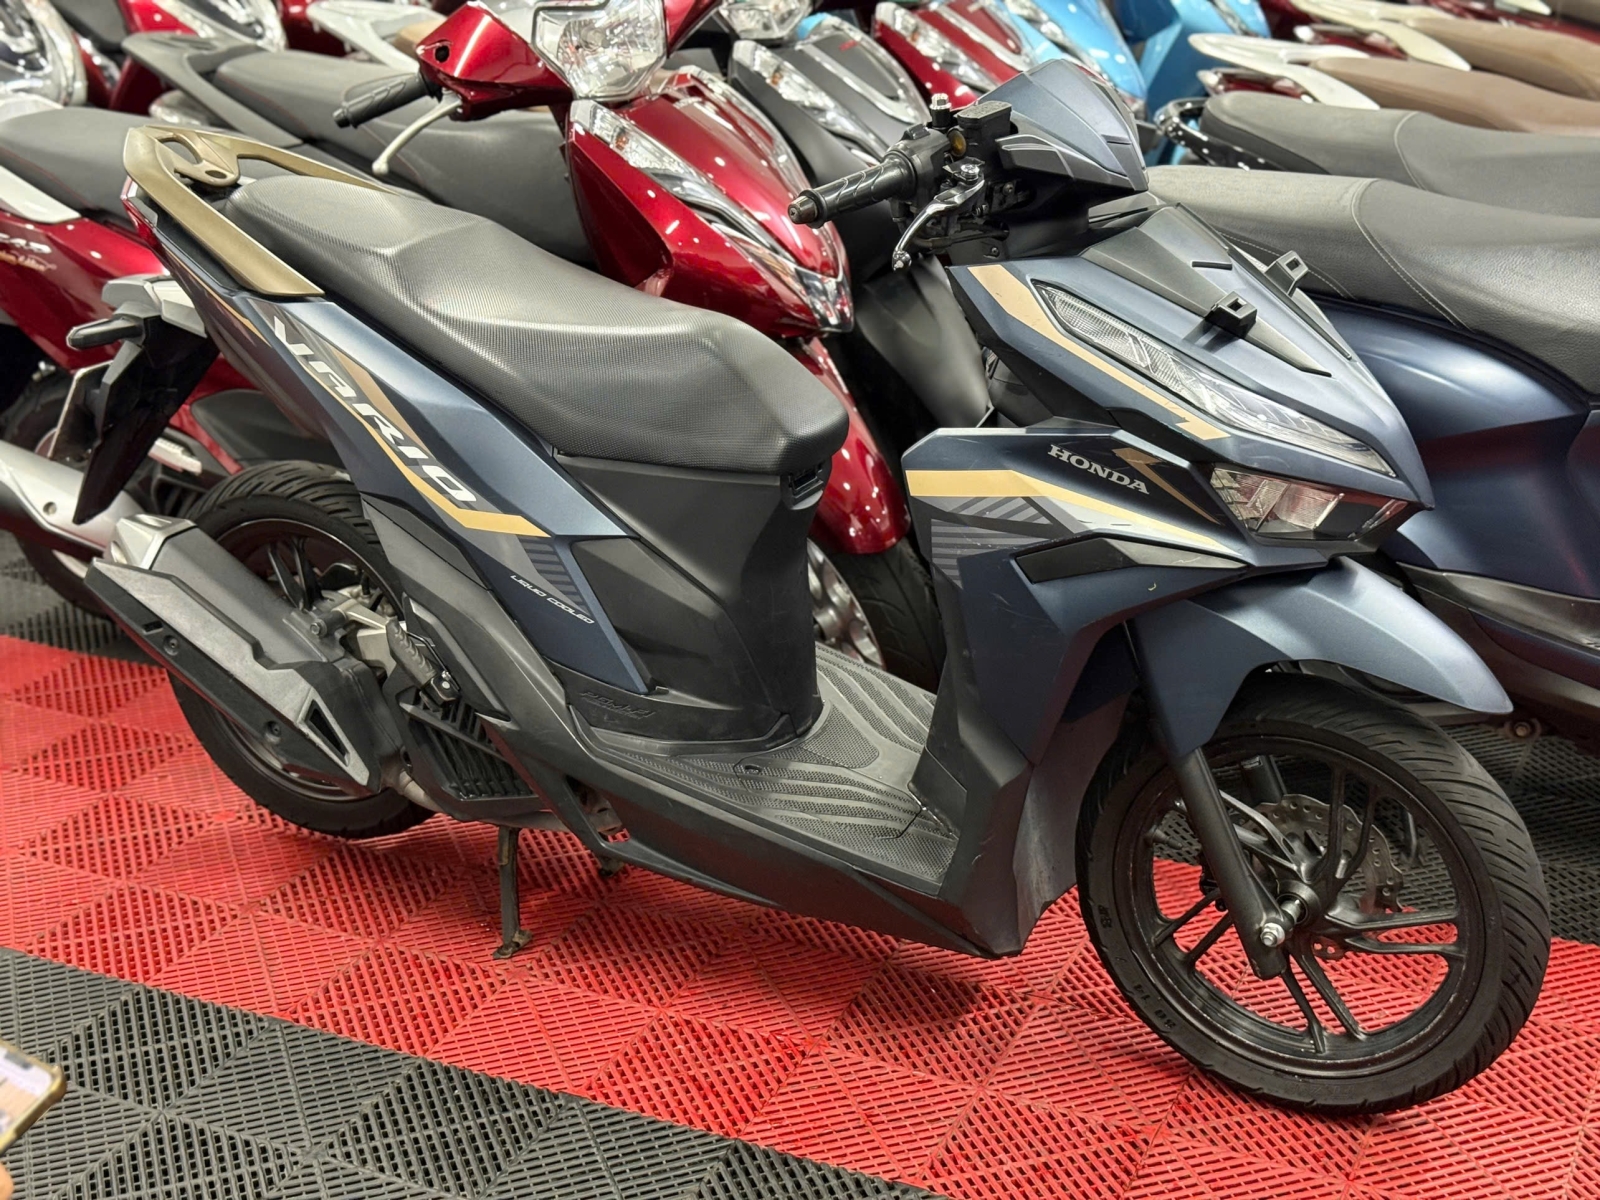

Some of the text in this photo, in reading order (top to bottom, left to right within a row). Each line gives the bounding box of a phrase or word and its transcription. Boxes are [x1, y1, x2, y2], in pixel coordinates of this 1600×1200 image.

[274, 316, 477, 502] VARIO
[1047, 444, 1150, 495] HONDA
[510, 574, 595, 624] LIQUID COOLED
